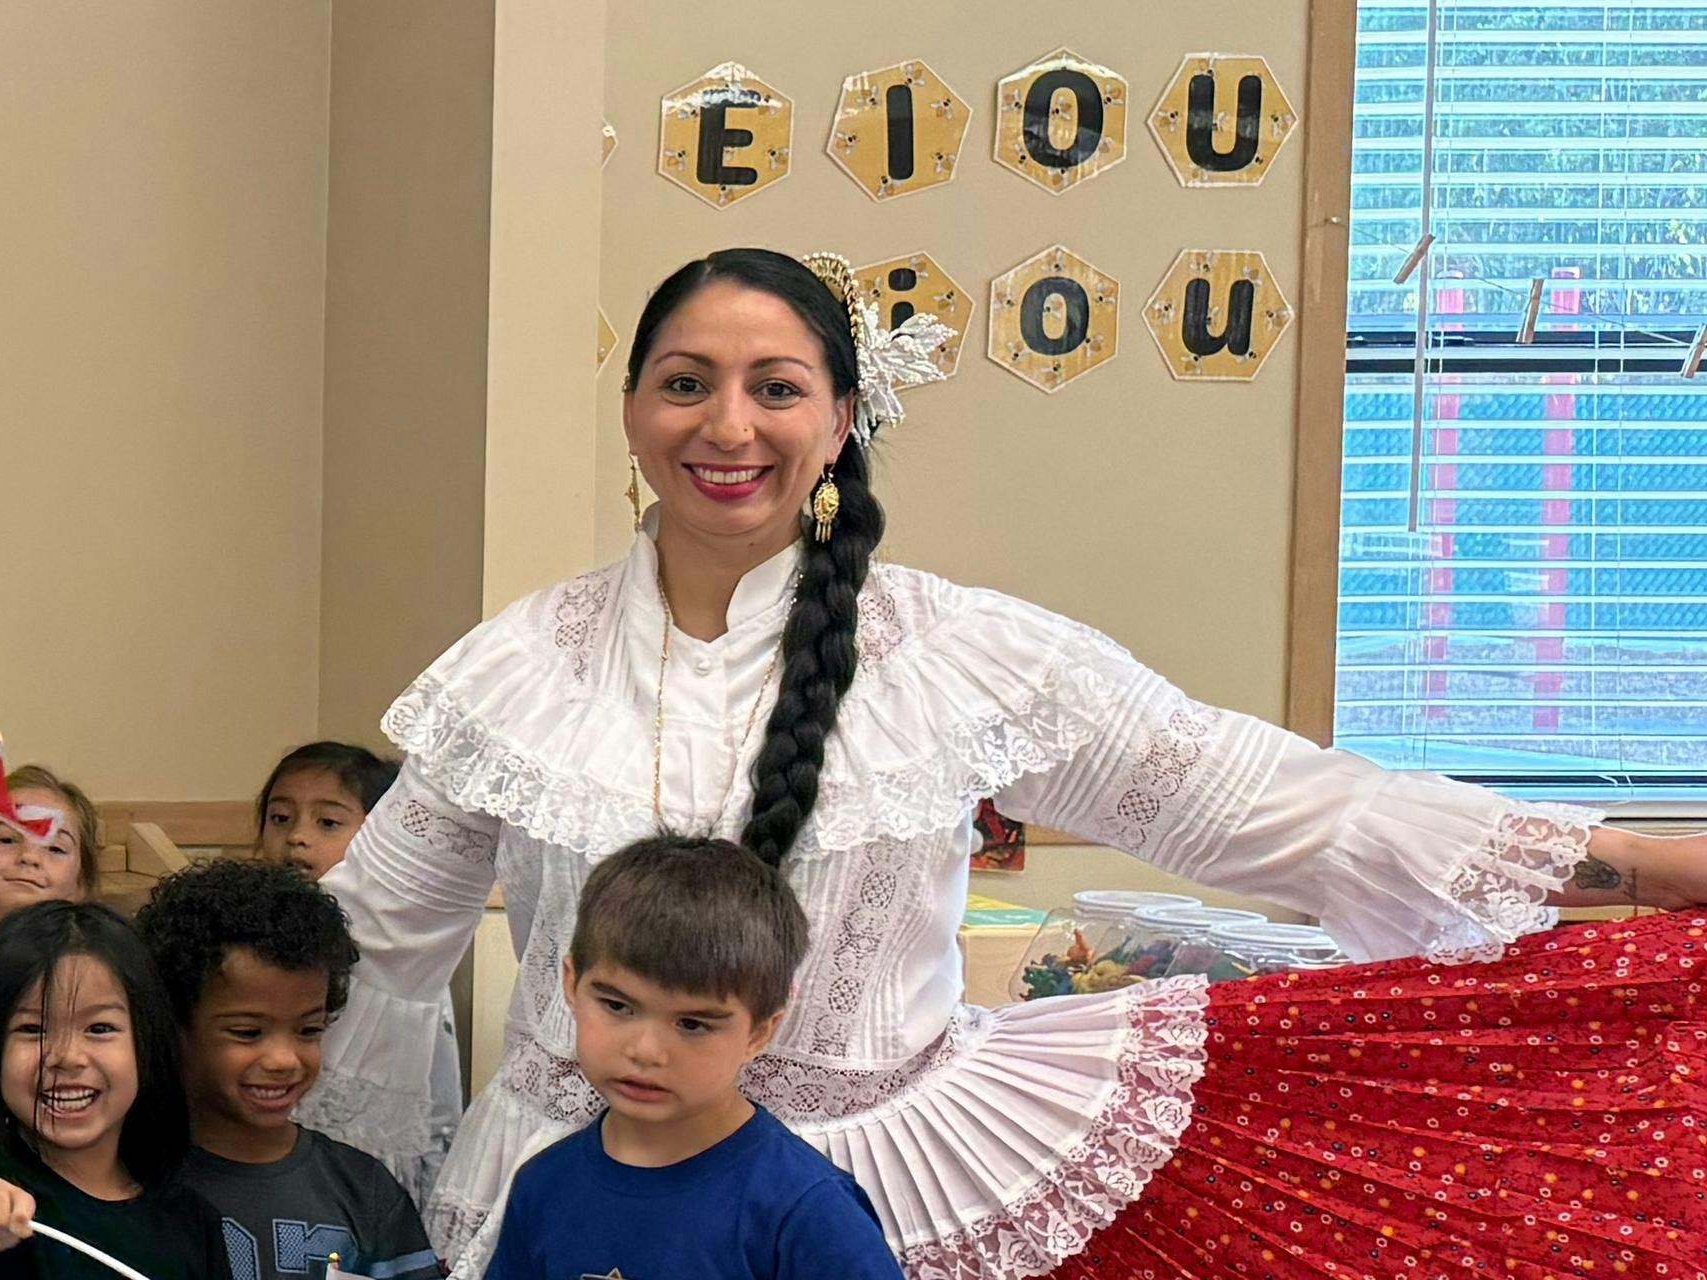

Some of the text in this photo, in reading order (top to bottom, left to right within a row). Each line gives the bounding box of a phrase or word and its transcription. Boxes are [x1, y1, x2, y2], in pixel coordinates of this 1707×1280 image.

[694, 87, 759, 186] E
[1022, 68, 1104, 168] O
[1186, 73, 1263, 173] U
[1018, 276, 1088, 357] o
[1180, 276, 1256, 357] u
